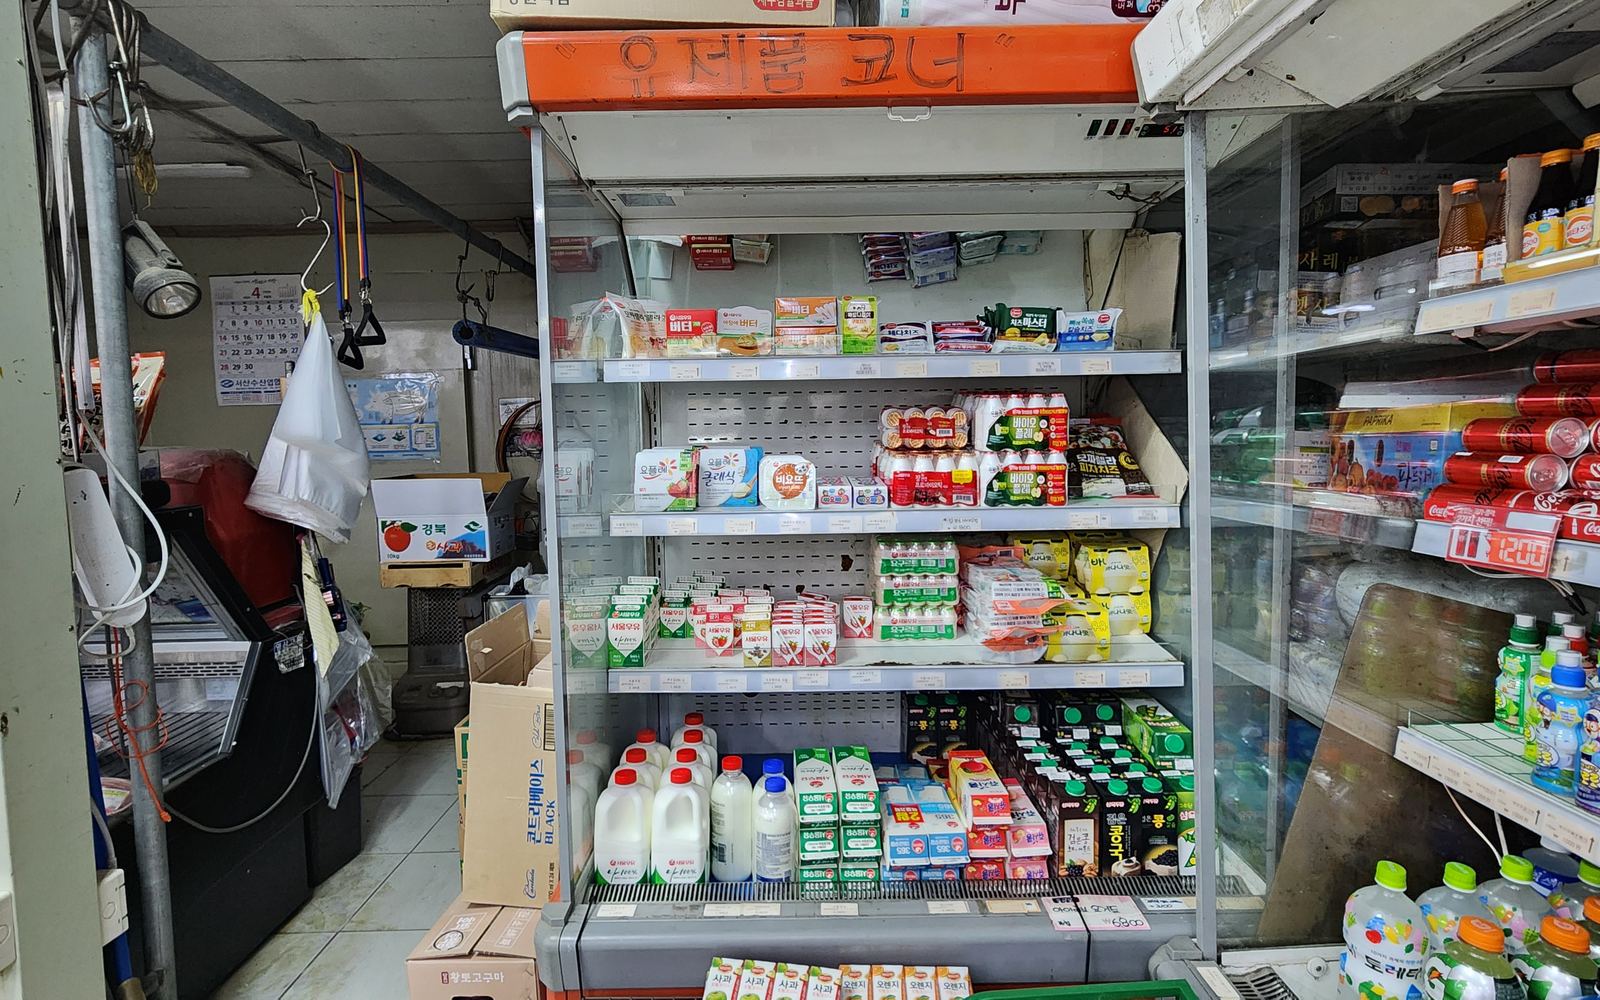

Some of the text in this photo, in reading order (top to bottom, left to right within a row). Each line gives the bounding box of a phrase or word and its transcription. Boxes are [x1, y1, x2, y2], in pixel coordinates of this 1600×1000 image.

[611, 33, 966, 98] 유제품 코너
[251, 287, 261, 299] 4
[669, 321, 692, 332] 버터
[739, 319, 758, 328] 버터
[1022, 317, 1047, 328] 마스터
[1013, 417, 1036, 428] 바이오
[1363, 414, 1394, 427] PAPRIKA
[1015, 428, 1033, 439] 플레
[639, 464, 668, 477] 요플레
[1079, 462, 1120, 474] 피자치즈
[702, 470, 736, 486] 클래식
[775, 474, 804, 485] 비요뜨
[1010, 473, 1034, 484] 바이오
[1013, 483, 1030, 494] 플레
[421, 523, 447, 536] 경북
[436, 539, 464, 553] 사과
[1499, 537, 1546, 566] 1200
[611, 623, 640, 631] 서울우유
[527, 759, 544, 844] 콘트라베이스
[803, 794, 825, 802] 서울우유
[845, 792, 867, 800] 서울우유
[544, 800, 556, 845] BLACK
[1106, 812, 1127, 825] 검은
[1151, 814, 1166, 829] 콩
[803, 831, 826, 839] 서울우유
[846, 829, 868, 837] 서울우유
[896, 846, 911, 854] 365
[936, 845, 951, 853] 365
[803, 870, 825, 878] 서울우유
[844, 870, 866, 878] 서울우유
[713, 974, 732, 983] 사과
[746, 977, 765, 986] 사과
[779, 980, 798, 990] 사과
[813, 983, 833, 993] 사과
[843, 980, 866, 989] 오렌지
[876, 980, 899, 989] 오렌지
[910, 981, 933, 990] 오렌지
[943, 982, 967, 991] 오렌지
